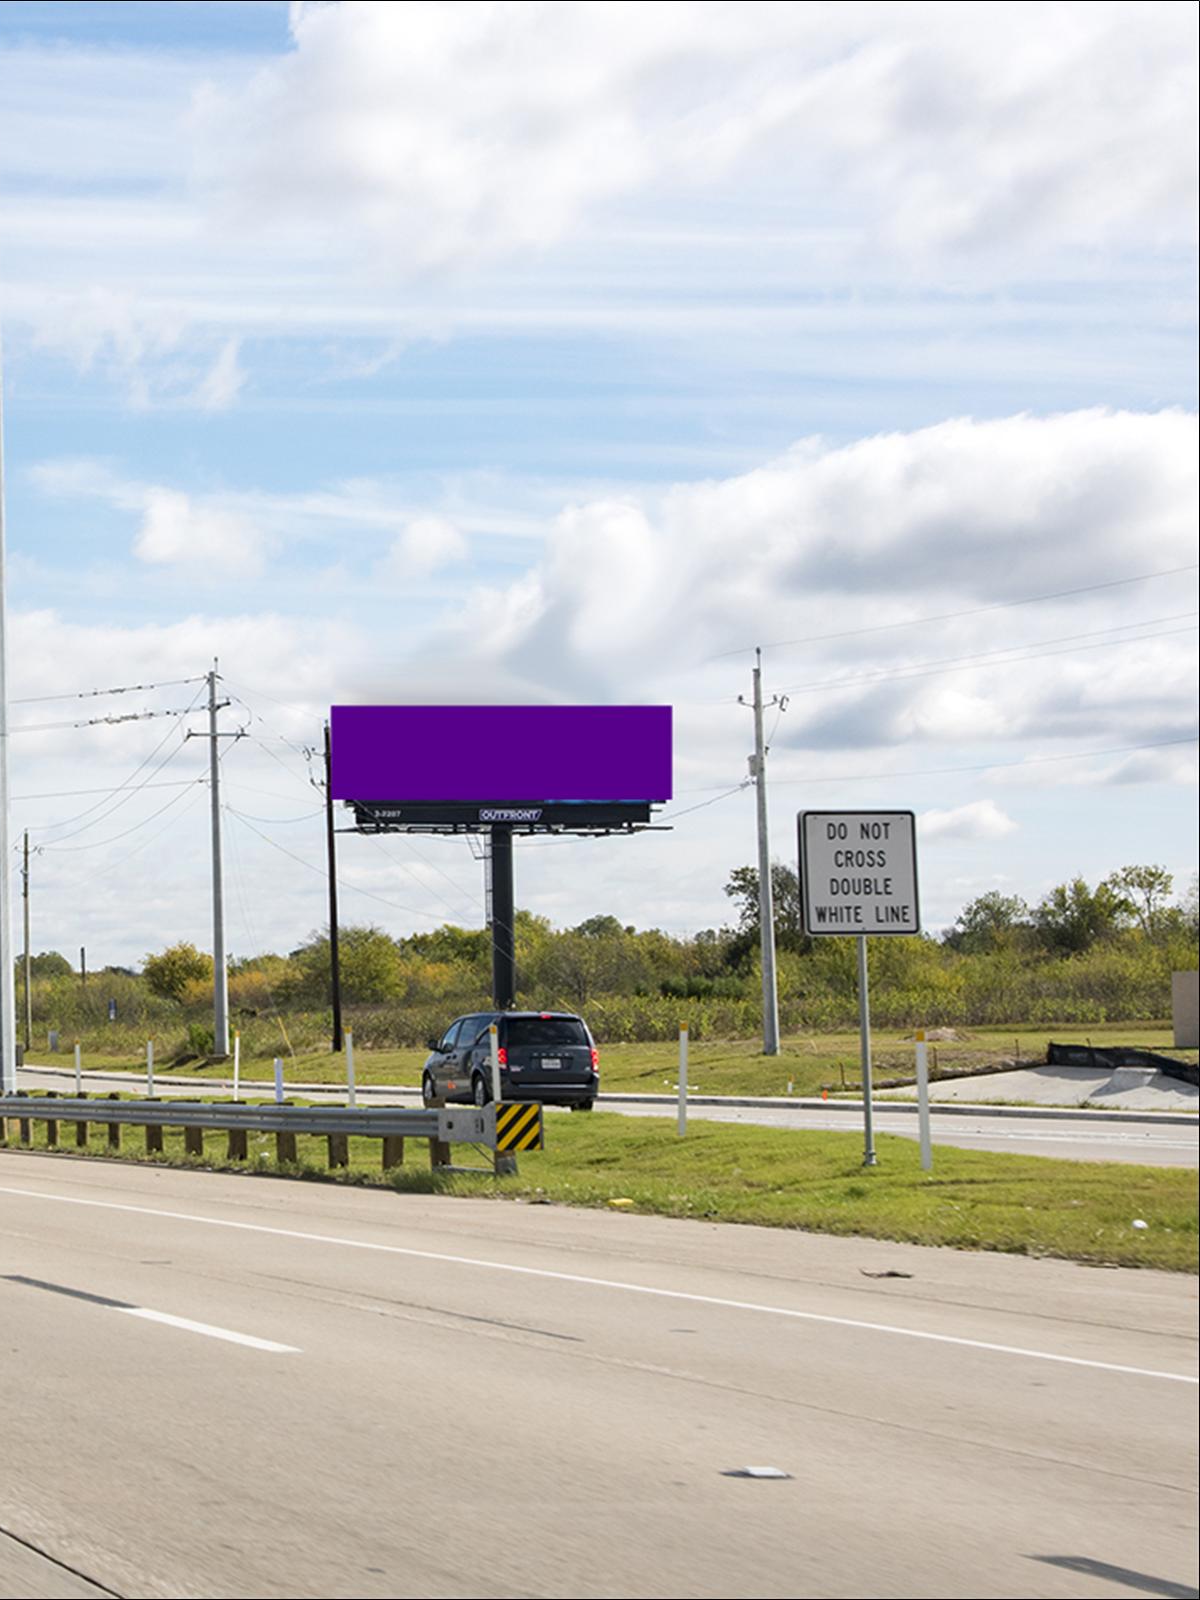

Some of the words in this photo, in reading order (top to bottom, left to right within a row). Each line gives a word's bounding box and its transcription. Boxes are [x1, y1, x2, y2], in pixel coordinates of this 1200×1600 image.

[482, 810, 540, 820] OUTFRONT
[827, 822, 848, 840] DO
[860, 822, 890, 840] NOT
[834, 850, 886, 868] CROSS
[830, 878, 893, 896] DOUBLE
[815, 906, 863, 923] WHITE
[875, 906, 910, 923] LINE
